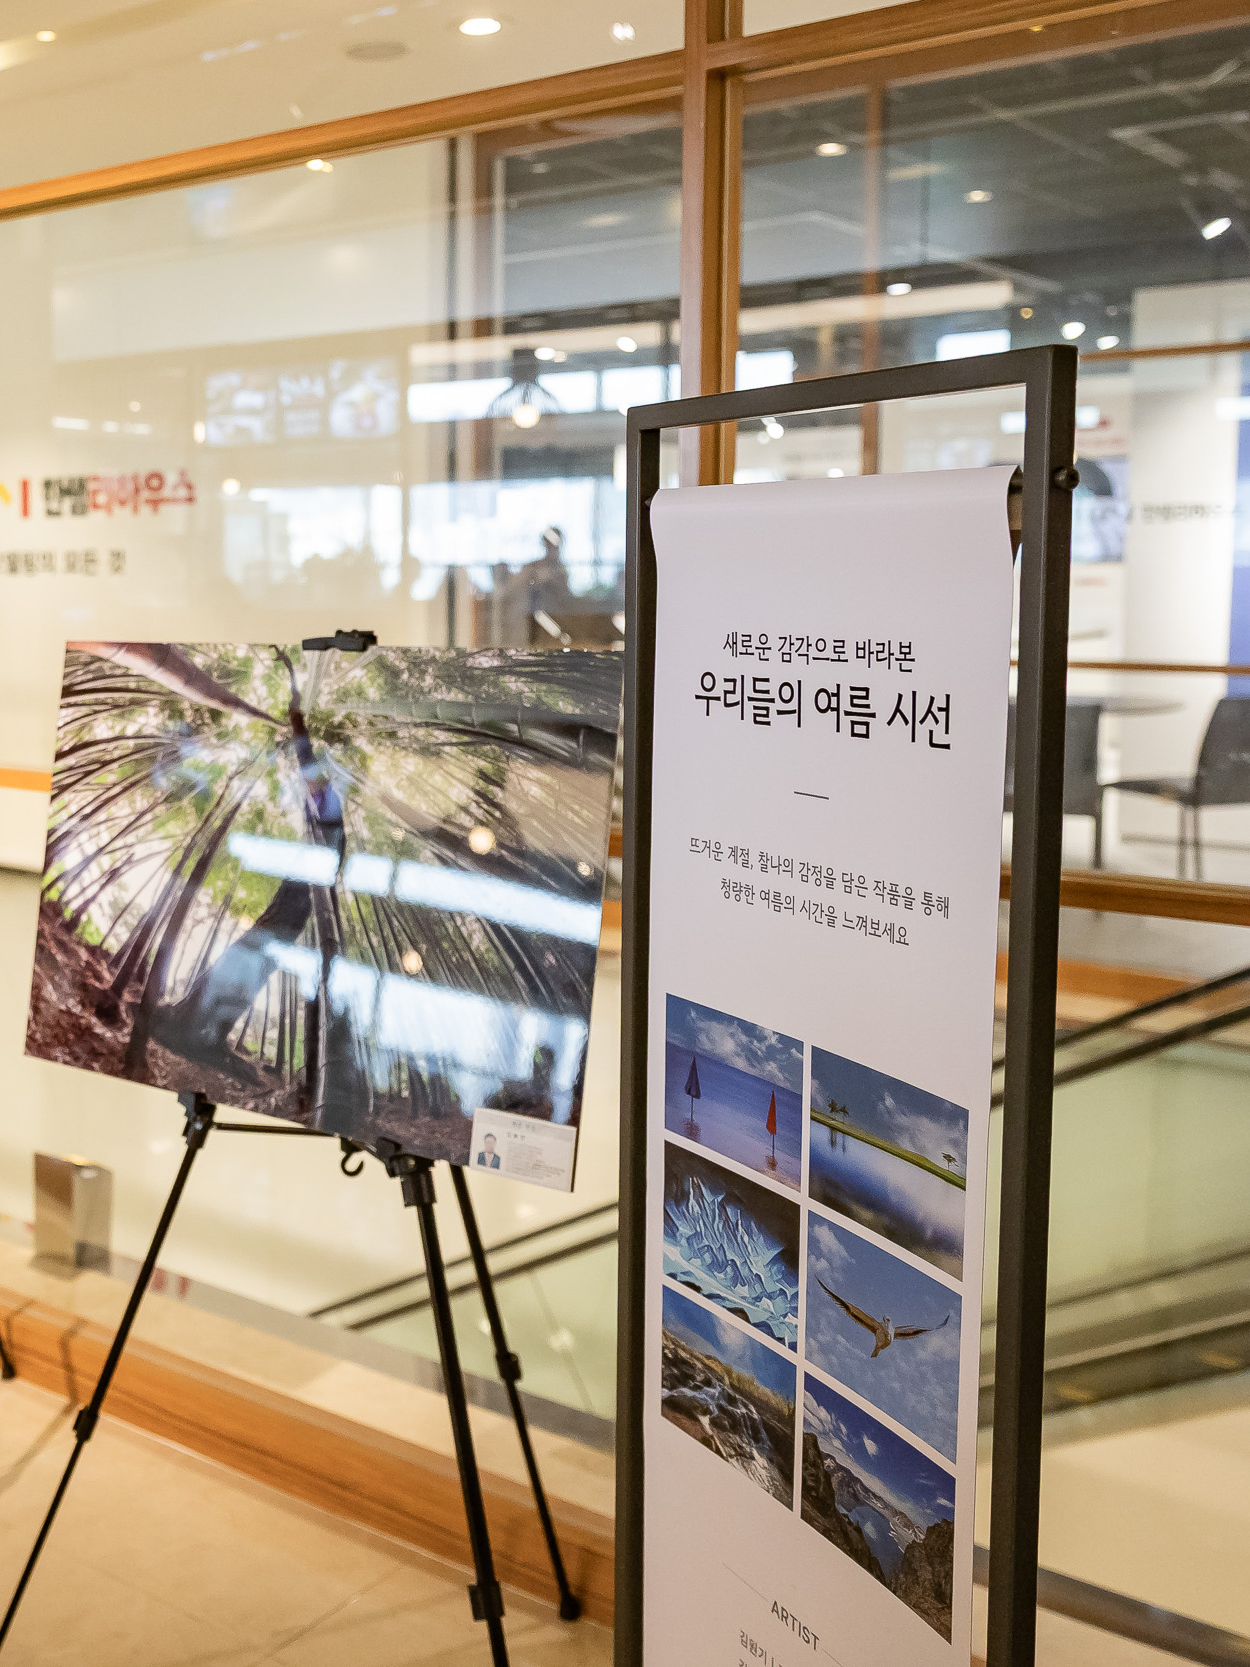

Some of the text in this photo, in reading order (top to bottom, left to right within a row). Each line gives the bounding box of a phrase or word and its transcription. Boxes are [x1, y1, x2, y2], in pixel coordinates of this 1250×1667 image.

[723, 632, 915, 673] 새로운 감각으로 바라본
[694, 671, 951, 750] 우리들의 여름 시선
[689, 837, 950, 919] 뜨거운 계절, 찰나의 감정을 담은 작품을 통해
[720, 877, 910, 946] 청량한 여름의 시간을 느껴보세요
[771, 1600, 820, 1651] ARTIST
